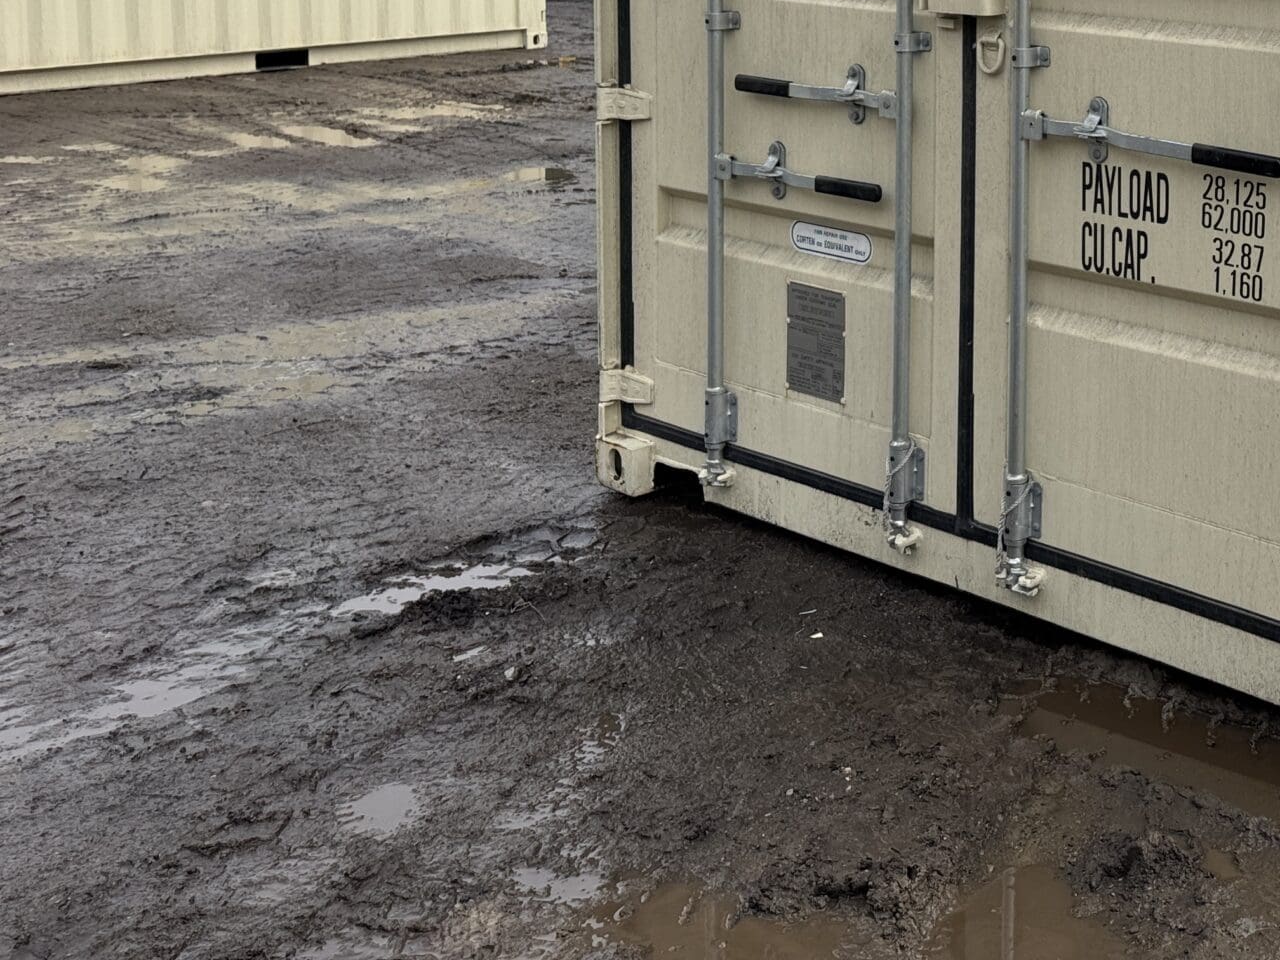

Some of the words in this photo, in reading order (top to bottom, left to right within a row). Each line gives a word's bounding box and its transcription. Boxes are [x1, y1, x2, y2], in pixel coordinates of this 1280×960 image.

[1082, 162, 1169, 224] PAYLOAD
[1202, 174, 1266, 210] 28,125
[1201, 202, 1265, 239] 62,000
[824, 240, 854, 253] EQUIVALENT
[1081, 221, 1156, 284] CU.CAP.
[1212, 238, 1264, 273] 32.87
[1213, 266, 1263, 302] 1,160
